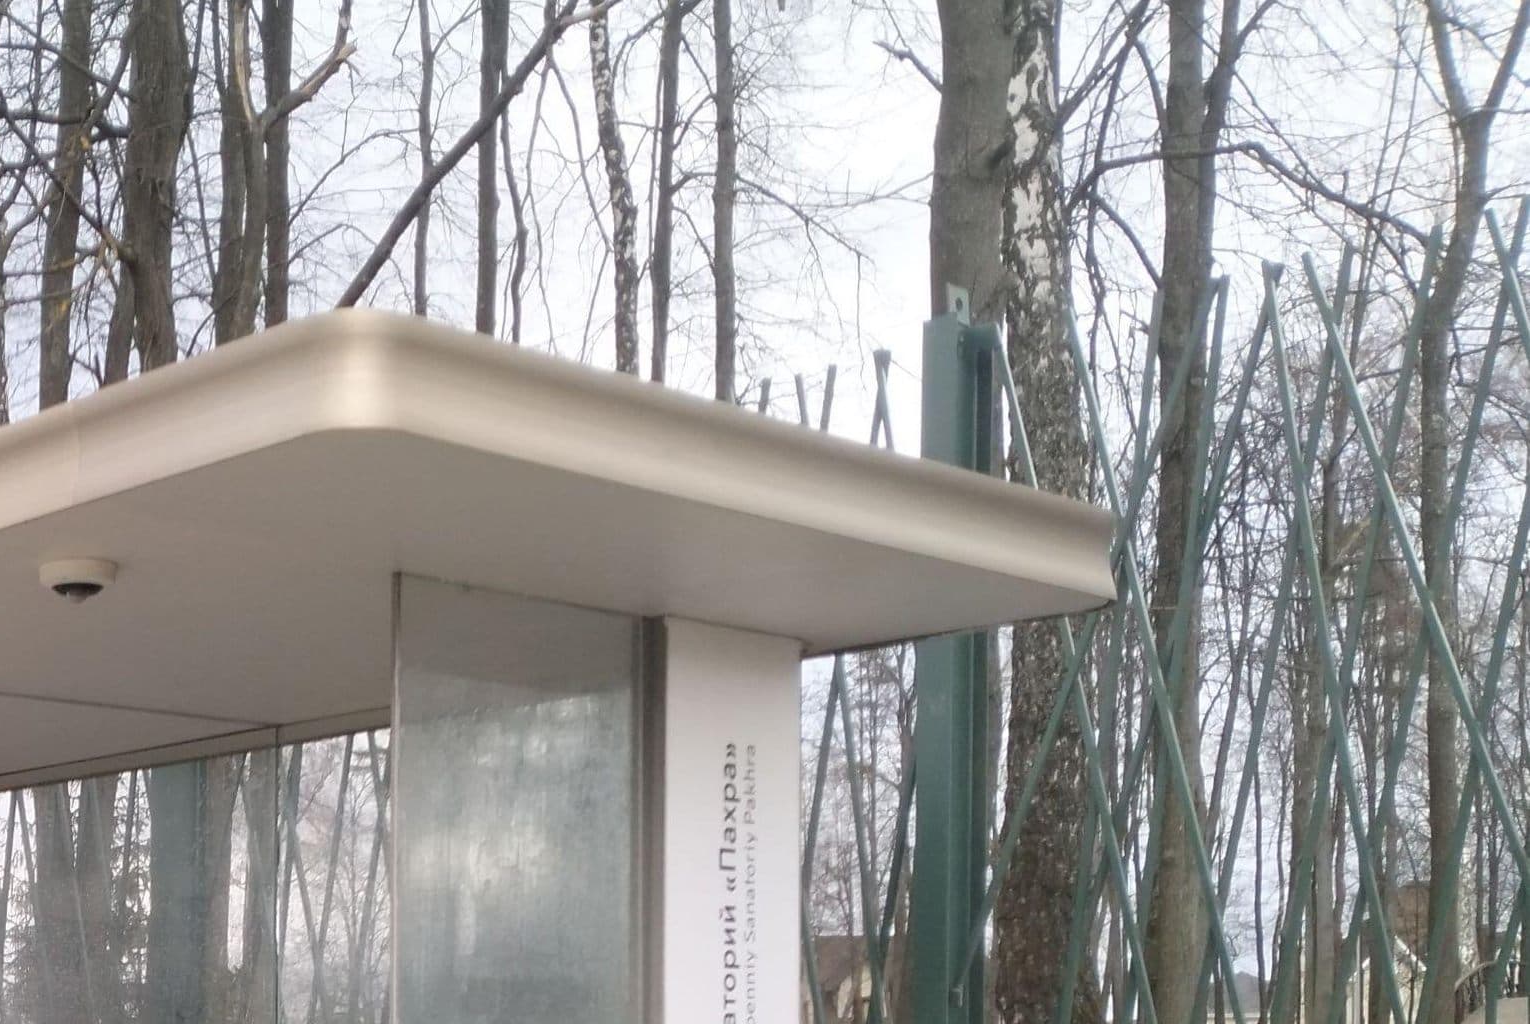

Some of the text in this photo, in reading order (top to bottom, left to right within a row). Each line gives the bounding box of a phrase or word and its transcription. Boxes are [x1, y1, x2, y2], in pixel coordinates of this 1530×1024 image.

[719, 743, 741, 892] «Пахра»
[743, 744, 757, 824] Pakhra
[743, 832, 758, 943] Sanatoriy
